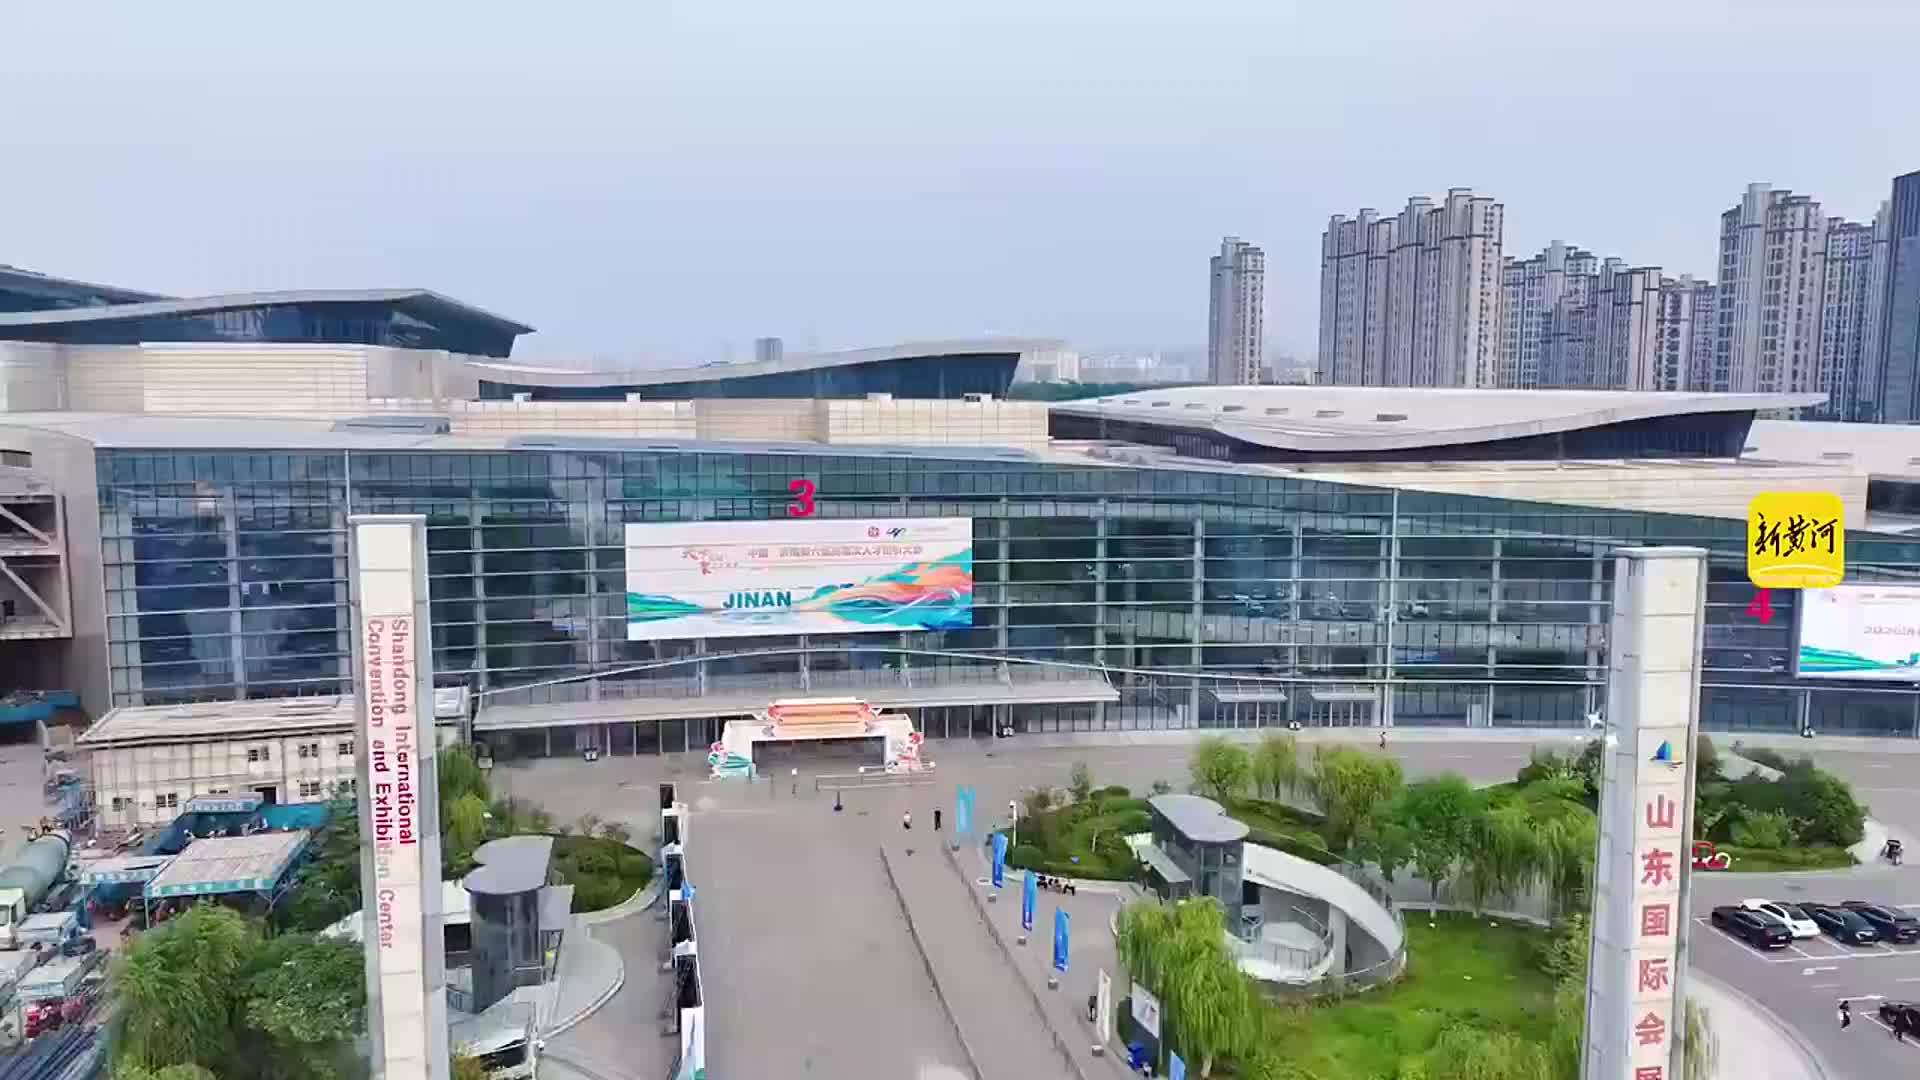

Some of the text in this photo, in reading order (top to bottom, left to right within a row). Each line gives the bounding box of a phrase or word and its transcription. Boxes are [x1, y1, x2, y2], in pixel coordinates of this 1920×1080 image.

[788, 479, 817, 518] 3
[722, 590, 792, 609] JINAN
[1744, 588, 1776, 625] 4
[367, 619, 388, 728] Convention
[391, 619, 417, 844] Shandong International
[372, 739, 390, 773] and
[378, 889, 396, 949] Center
